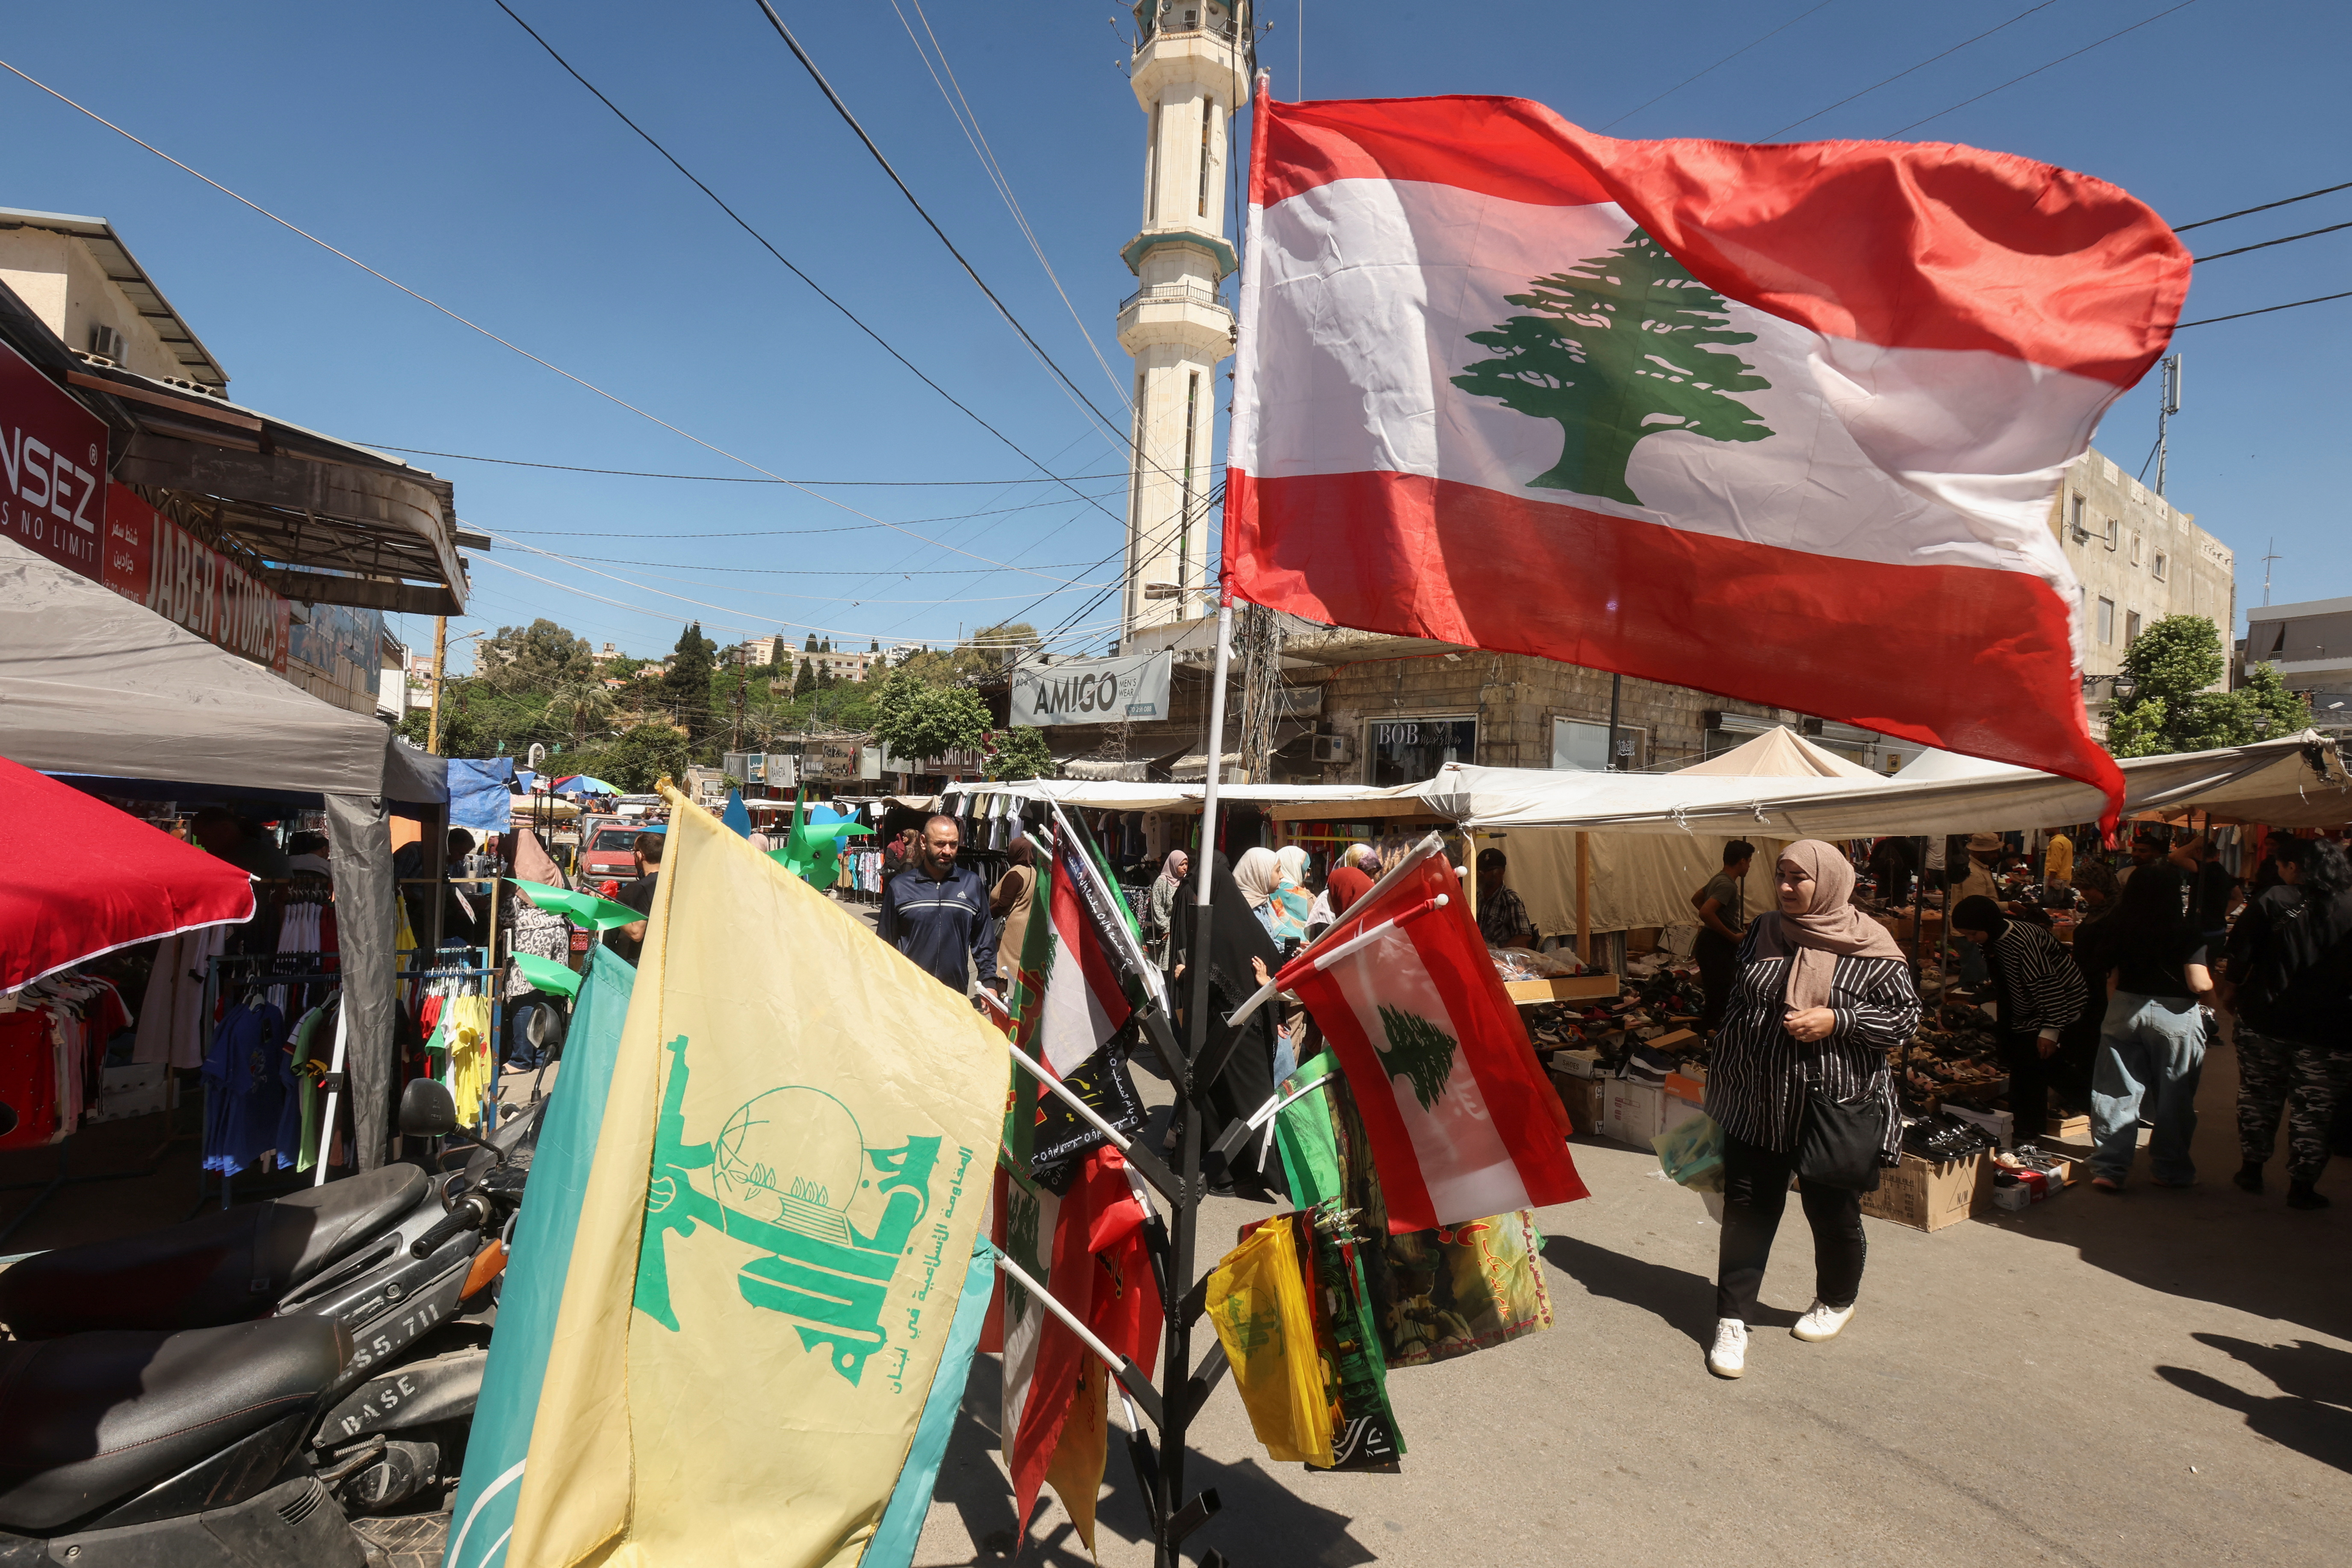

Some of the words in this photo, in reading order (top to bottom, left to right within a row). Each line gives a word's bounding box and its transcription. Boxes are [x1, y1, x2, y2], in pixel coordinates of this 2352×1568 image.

[21, 510, 43, 540] NO
[54, 526, 94, 562] LIMIT
[146, 512, 216, 635] JABER
[220, 561, 278, 661] STORES
[1033, 671, 1117, 715] AMIGO
[1119, 678, 1136, 688] MEN'S
[1119, 688, 1133, 697] WEAR
[1379, 724, 1418, 745] BOB
[771, 767, 786, 777] RAMETA
[1563, 1060, 1580, 1070] SHOES
[1111, 1069, 1129, 1099] المصائب
[1060, 1134, 1083, 1153] المصائب
[942, 1146, 973, 1218] المقاومة
[1957, 1190, 1968, 1205] N/M
[1489, 1275, 1506, 1293] الله
[1483, 1296, 1511, 1321] سلام
[907, 1308, 920, 1339] في
[888, 1347, 910, 1394] لبنان
[341, 1375, 415, 1436] BASE
